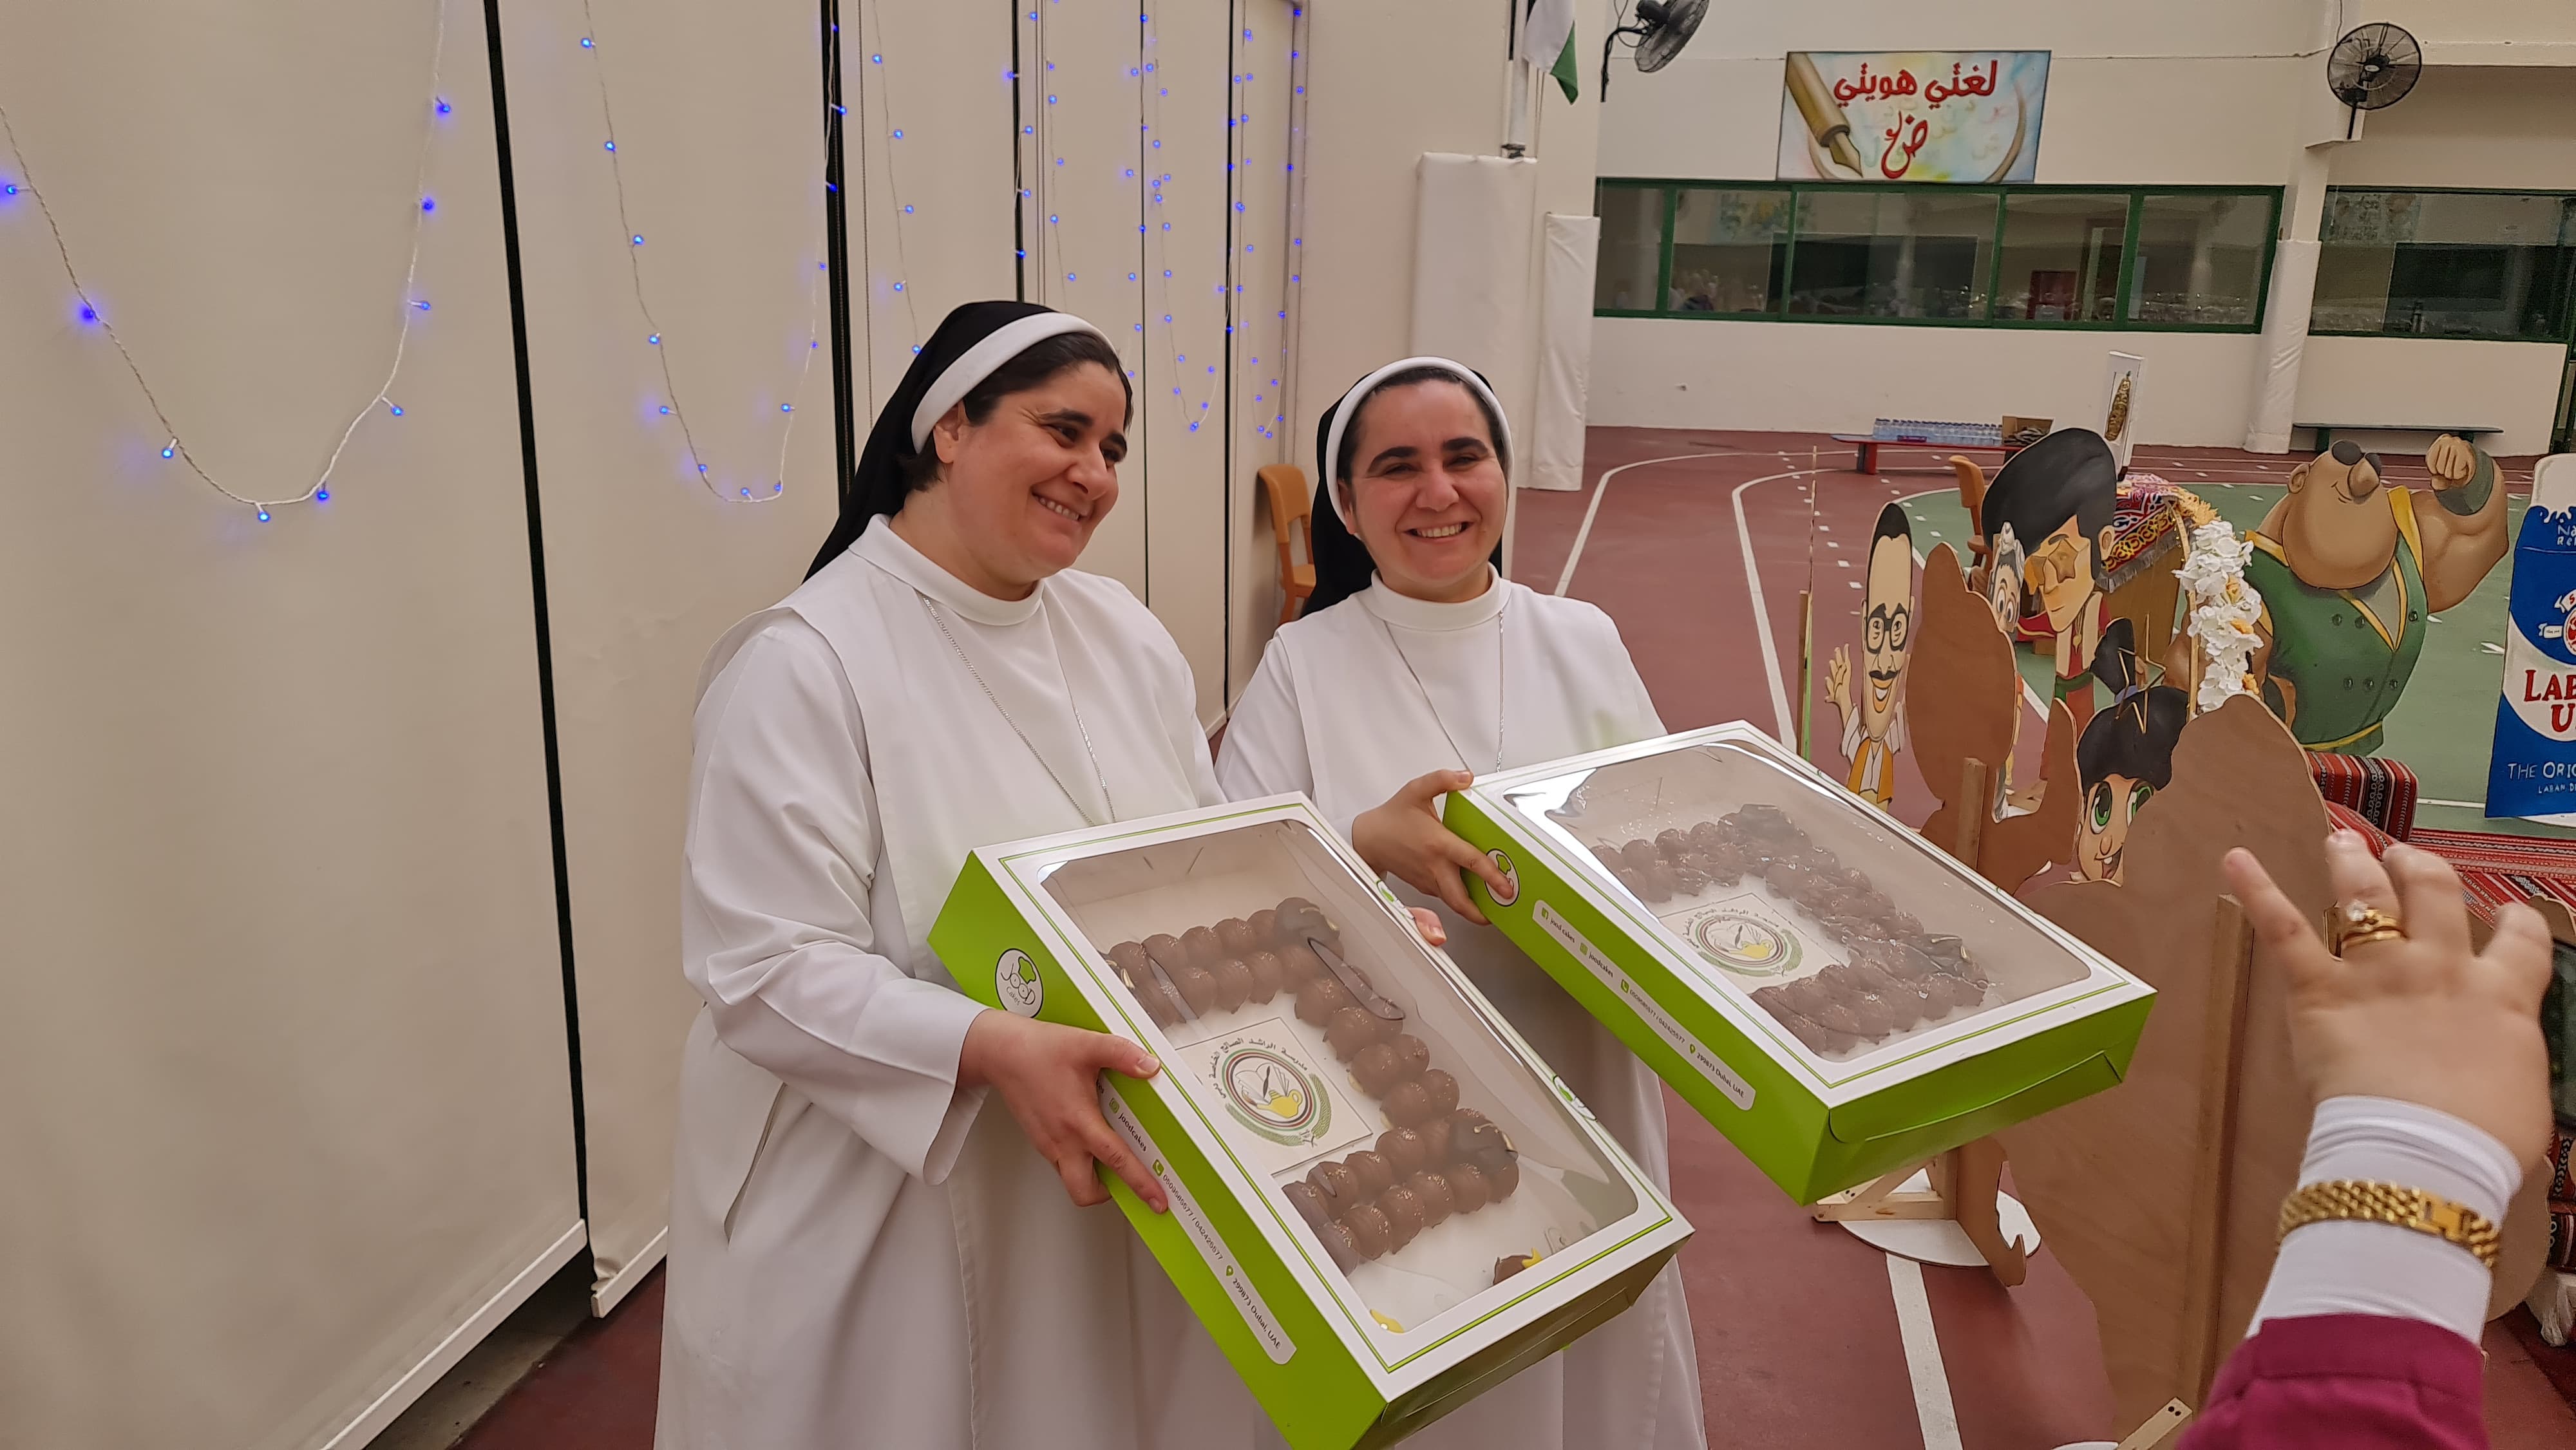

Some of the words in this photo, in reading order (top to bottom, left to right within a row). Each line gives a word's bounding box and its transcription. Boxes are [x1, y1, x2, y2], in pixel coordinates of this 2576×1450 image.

[1833, 62, 1918, 108] هويتي
[1924, 59, 1999, 109] لغتي
[2507, 762, 2538, 780] THE
[1732, 1083, 1745, 1098] UAE
[1117, 1112, 1148, 1153] joodcakes
[1232, 1277, 1253, 1308] 299873
[1267, 1329, 1282, 1350] UAE
